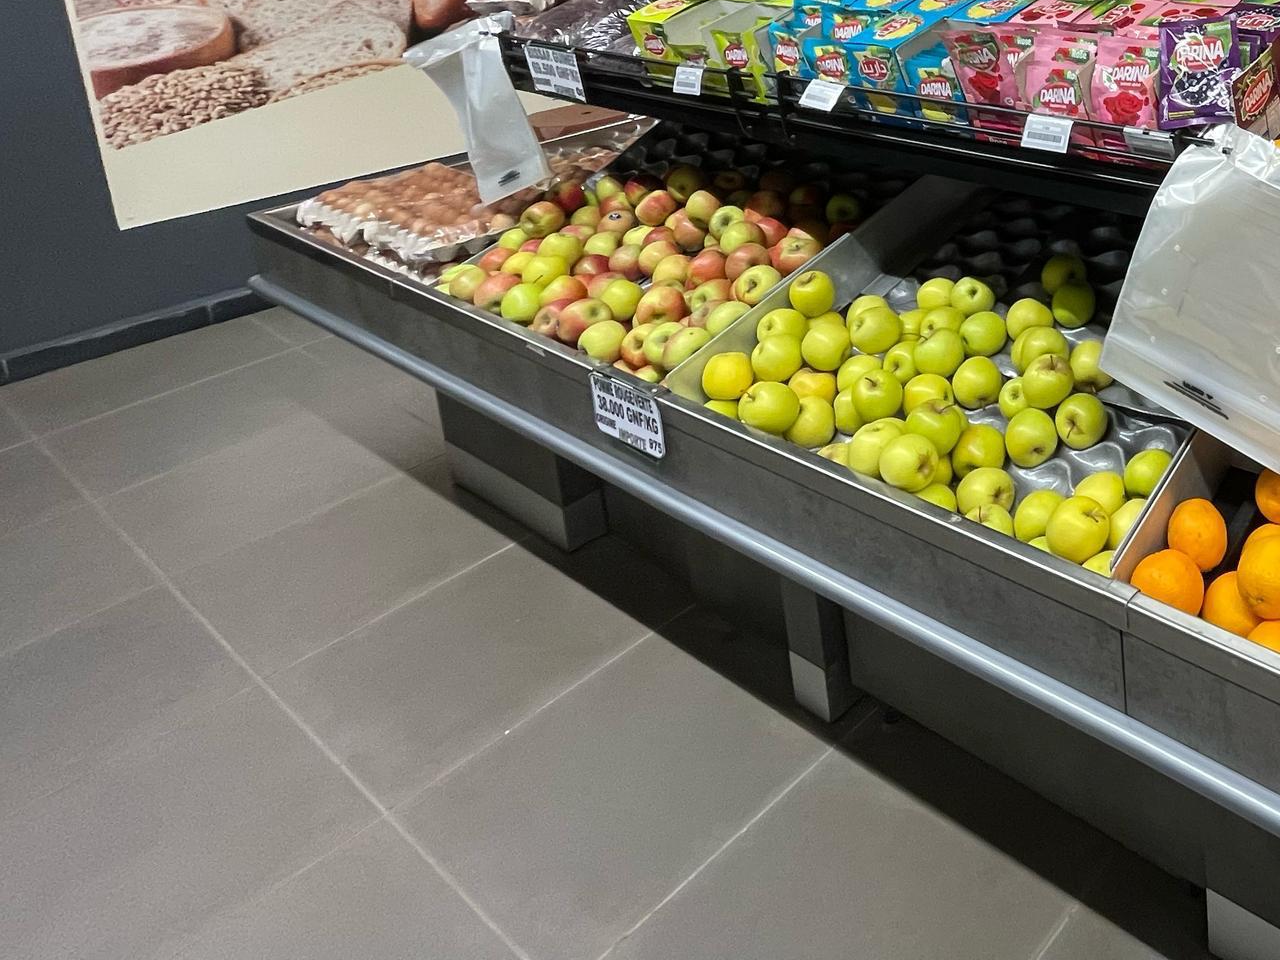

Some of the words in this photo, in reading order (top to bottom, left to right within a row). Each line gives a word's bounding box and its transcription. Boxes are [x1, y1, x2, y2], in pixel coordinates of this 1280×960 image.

[817, 58, 845, 72] DARIN
[1112, 65, 1150, 82] DARINA
[920, 82, 951, 97] DARINA
[1040, 86, 1075, 105] DARINA
[1244, 72, 1272, 113] DARINA
[597, 394, 625, 419] 38.000
